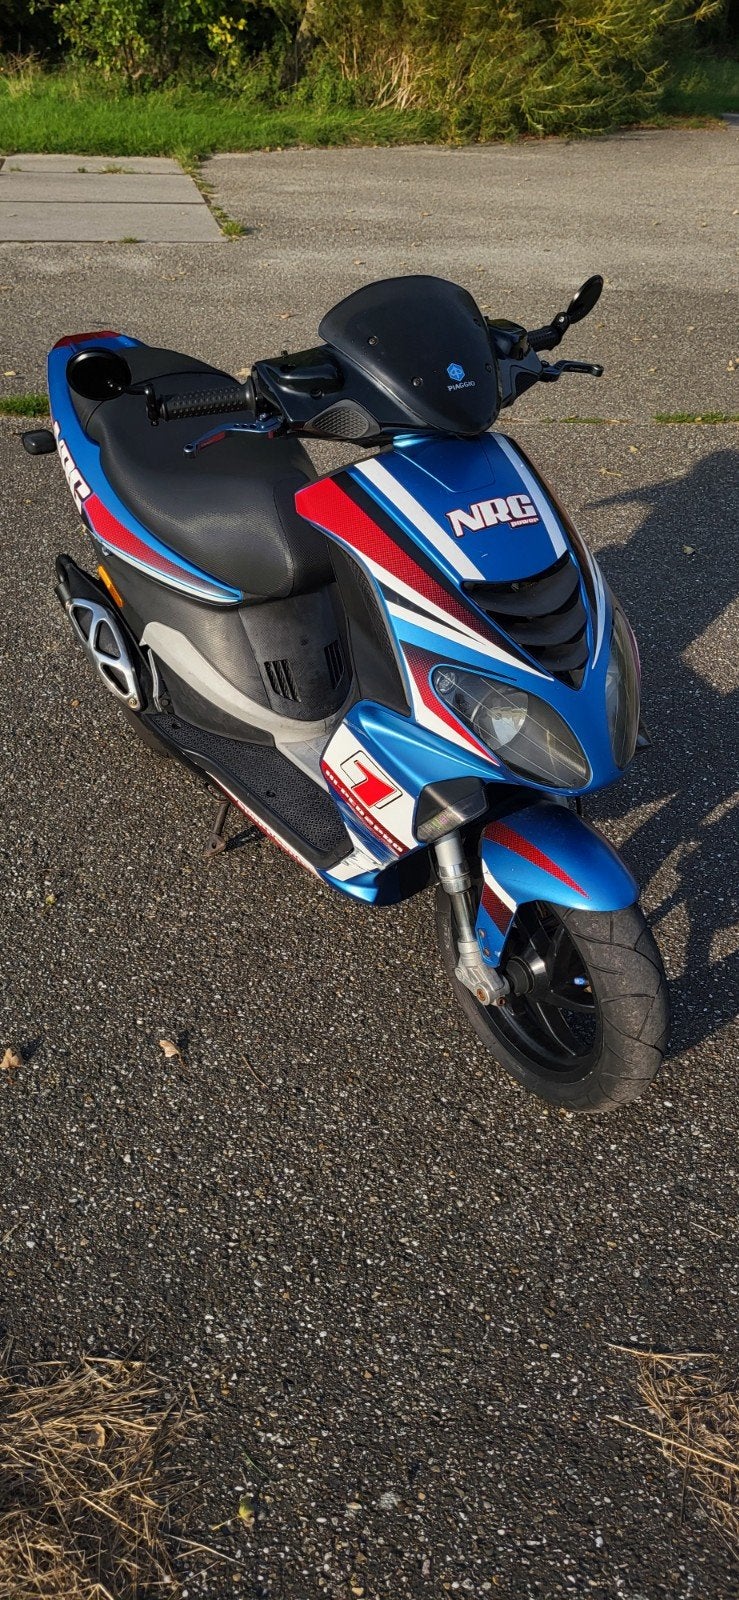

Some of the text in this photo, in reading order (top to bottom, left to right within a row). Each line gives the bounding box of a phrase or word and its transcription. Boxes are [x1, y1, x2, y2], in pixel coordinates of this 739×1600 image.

[447, 381, 476, 391] PIAGGIO
[446, 494, 538, 538] NRG
[511, 517, 540, 529] power
